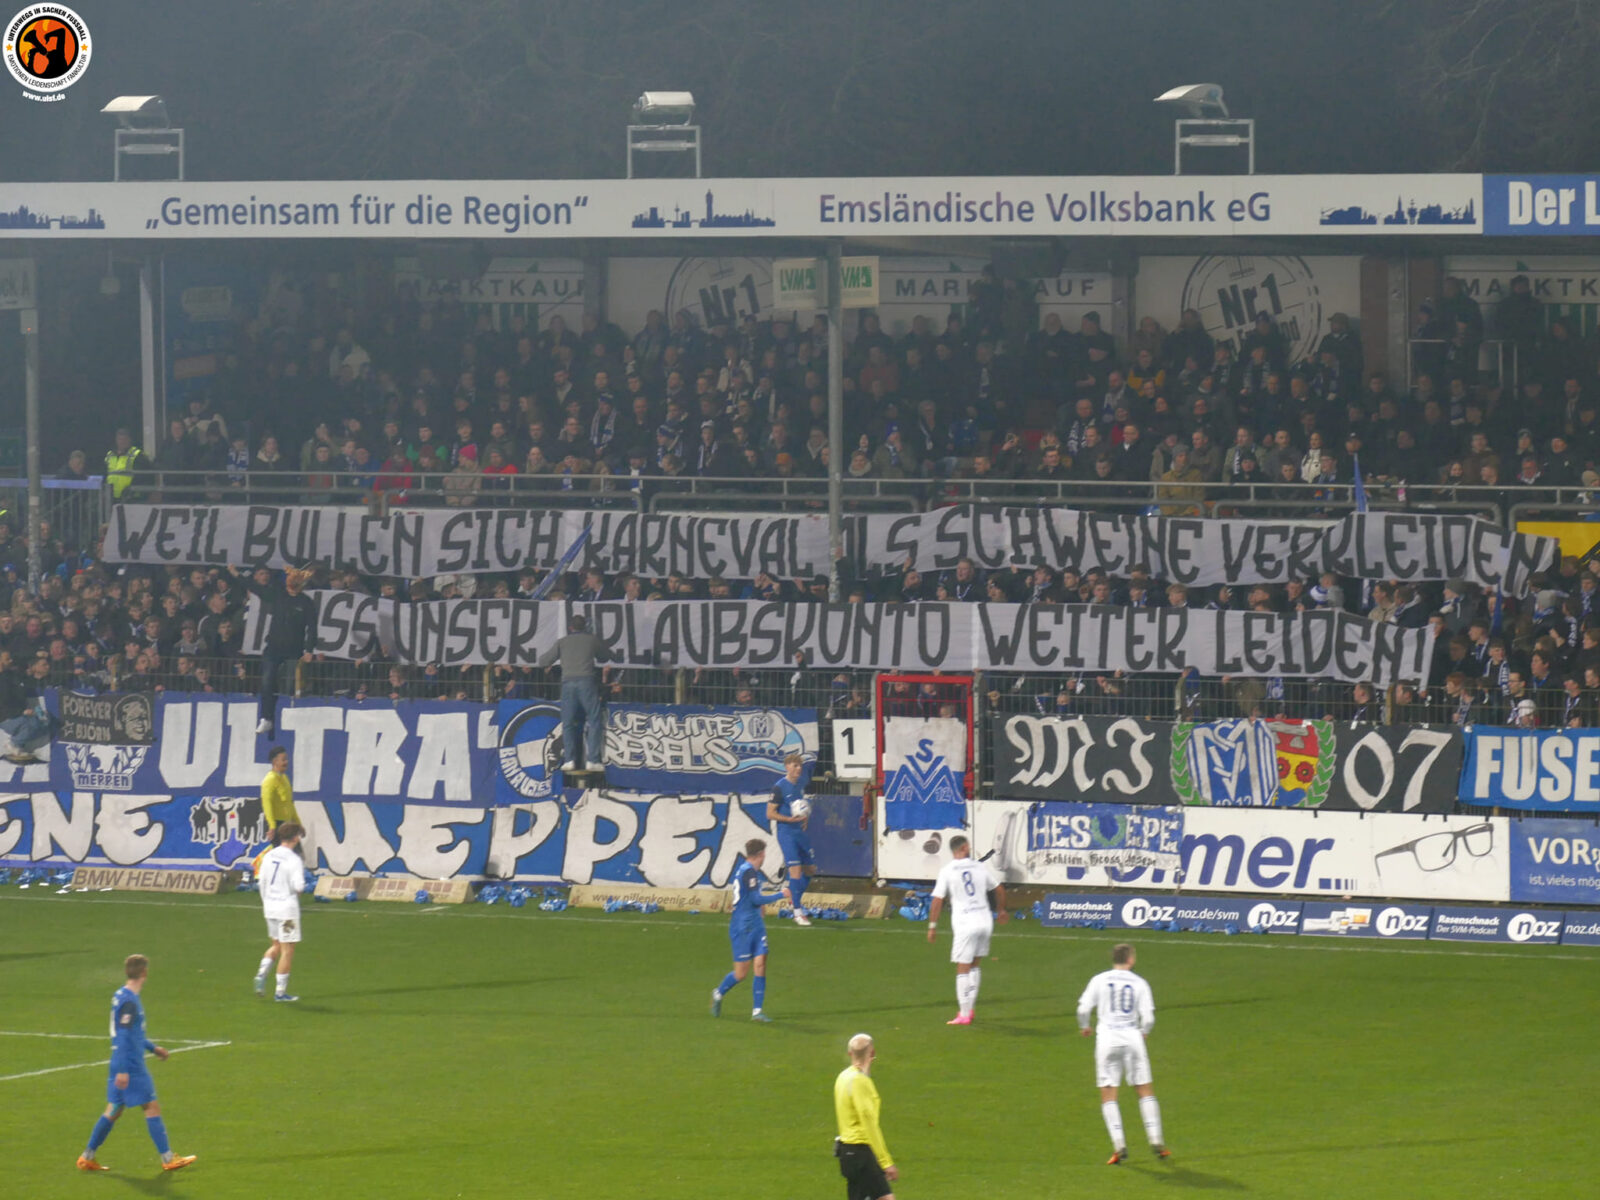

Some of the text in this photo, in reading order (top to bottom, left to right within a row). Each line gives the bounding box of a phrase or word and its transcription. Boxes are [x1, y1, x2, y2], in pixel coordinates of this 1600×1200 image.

[350, 194, 395, 225] für
[405, 194, 452, 225] die
[819, 191, 1270, 223] Emsländische Volksbank eG
[1508, 181, 1575, 225] Der
[1217, 273, 1282, 330] Nr1
[116, 504, 228, 562] WEIL
[242, 505, 424, 577] BULLEN
[437, 510, 563, 573] SICH
[583, 511, 814, 578] KARNEVAL
[934, 503, 1203, 584] SCHWEINE
[1221, 513, 1548, 597] VERKLEIDEN
[393, 601, 539, 664] UNSER
[977, 602, 1188, 671] WEITER
[63, 695, 112, 720] FOREVER
[649, 714, 738, 738] WHITE
[602, 729, 740, 775] REBELS
[840, 727, 855, 755] 1
[1343, 729, 1452, 810] 07
[1474, 735, 1600, 802] FUSE
[293, 793, 784, 889] MEPPEN
[74, 871, 217, 892] BMW HELMING
[272, 861, 280, 885] 7
[962, 871, 975, 897] 8
[1049, 911, 1112, 921] Der SVM-Podcast
[1050, 901, 1113, 911] Rasenschnack
[1127, 902, 1239, 923] noz noz.de/svm
[1253, 906, 1300, 927] noz
[1382, 910, 1429, 932] noz
[1436, 924, 1498, 935] Der SVM-Podcast
[1438, 914, 1500, 926] Rasenschnack
[1513, 916, 1560, 938] noz
[1107, 982, 1135, 1013] 10
